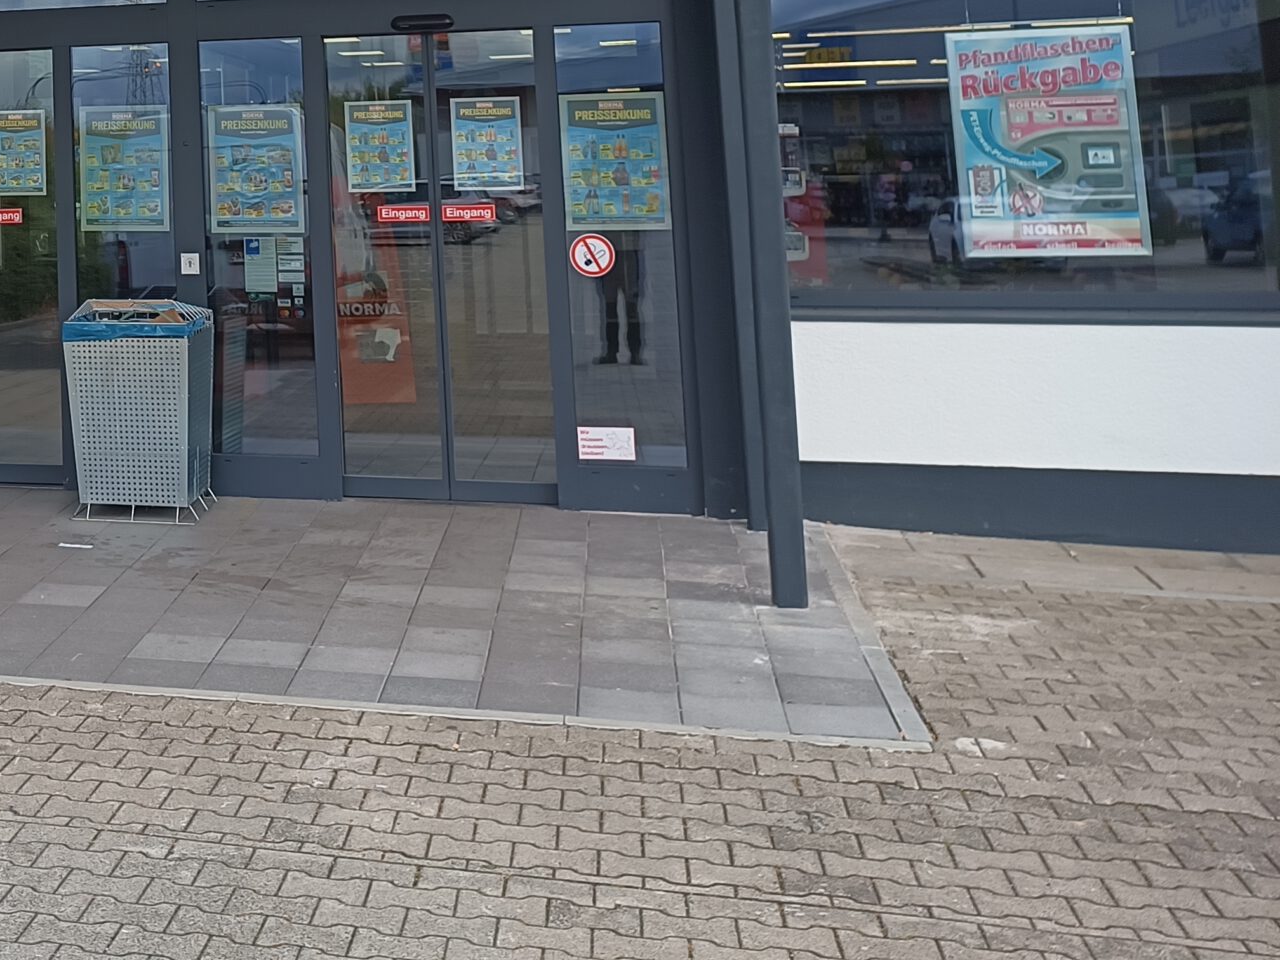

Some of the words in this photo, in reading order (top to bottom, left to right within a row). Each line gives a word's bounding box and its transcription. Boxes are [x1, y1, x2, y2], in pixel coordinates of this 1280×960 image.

[958, 34, 1122, 71] Pfandflaschen-
[959, 57, 1125, 101] Rückgabe
[575, 109, 651, 121] PREISSENKUNG
[91, 120, 156, 131] PREISSENKUNG
[221, 119, 288, 130] PREISSENKUNG
[381, 208, 426, 220] Eingang
[446, 207, 492, 219] Eingang
[1022, 223, 1087, 236] NORMA
[339, 302, 401, 316] NORMA
